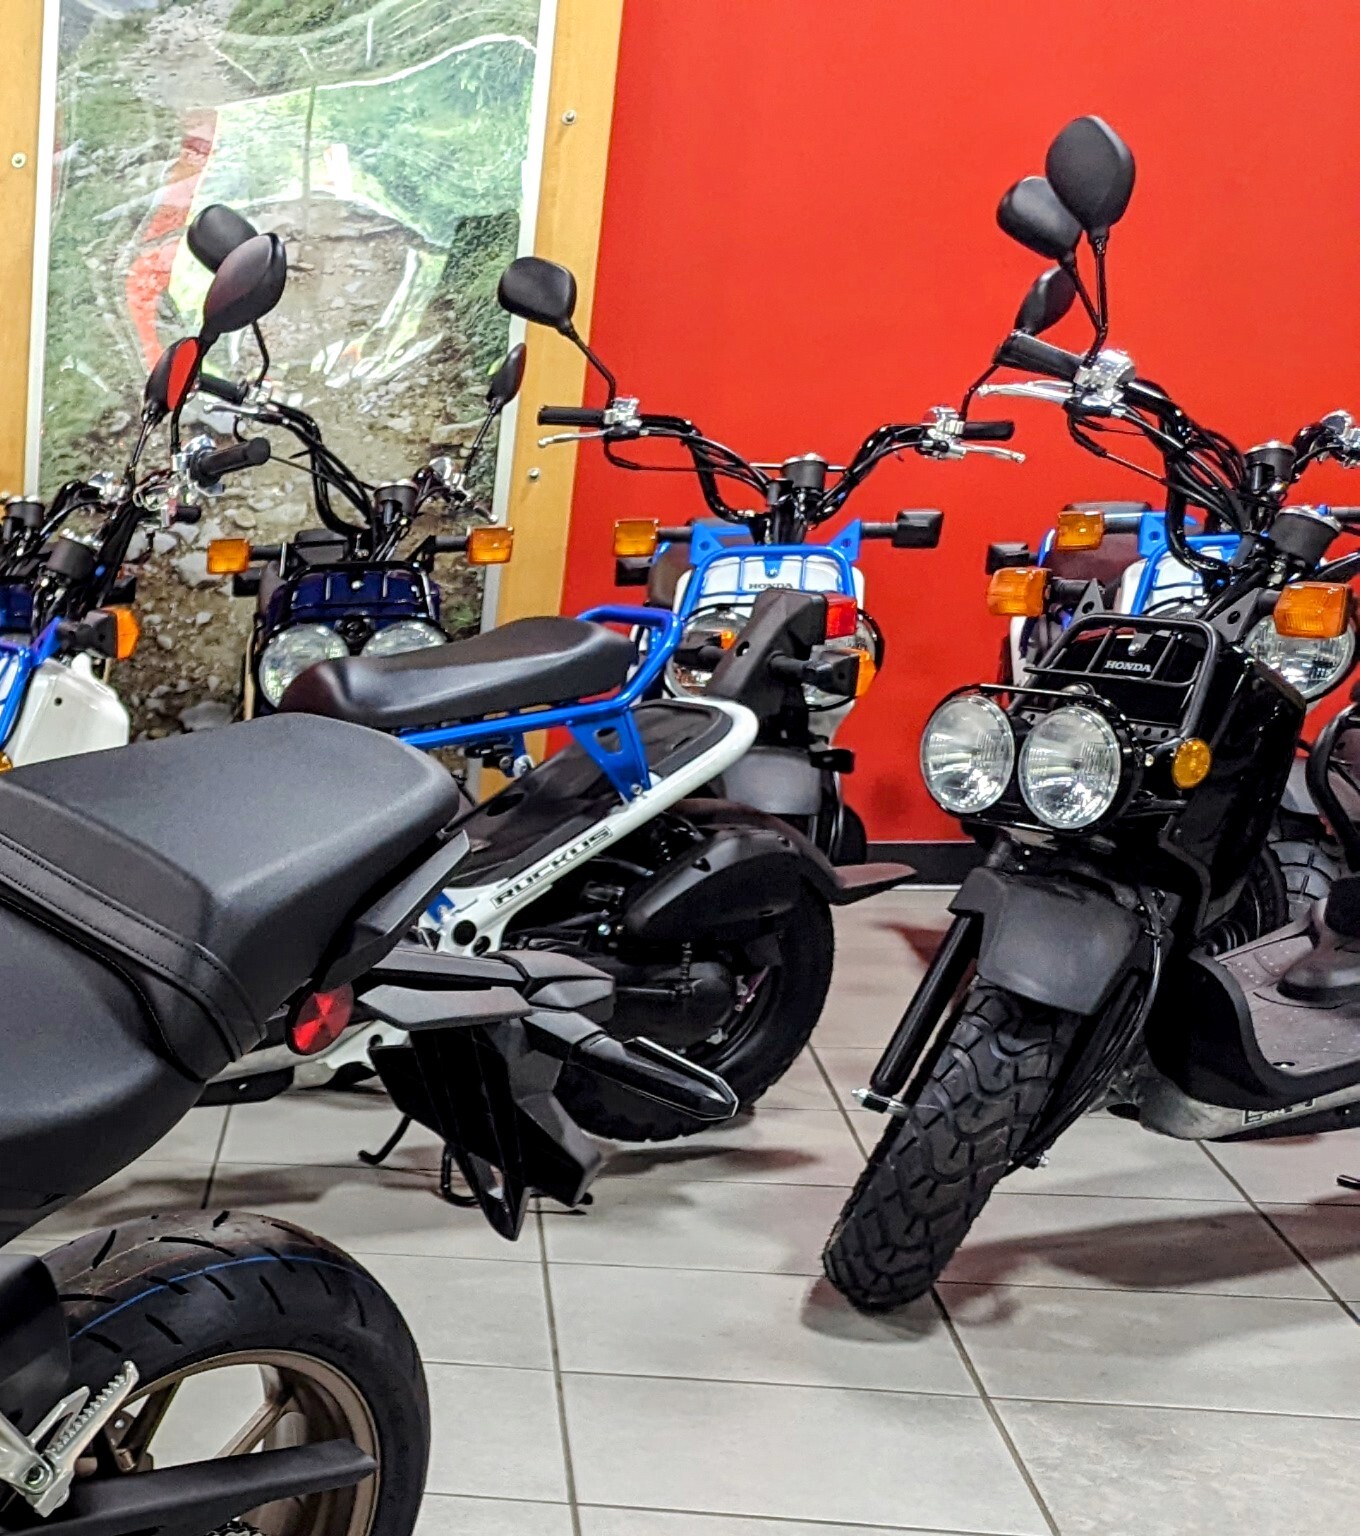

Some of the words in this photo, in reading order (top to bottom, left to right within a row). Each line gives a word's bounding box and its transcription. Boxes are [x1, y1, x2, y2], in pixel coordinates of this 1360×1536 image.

[747, 582, 793, 590] HONDA
[1104, 660, 1151, 673] HONDA
[494, 828, 611, 905] RUCKUS
